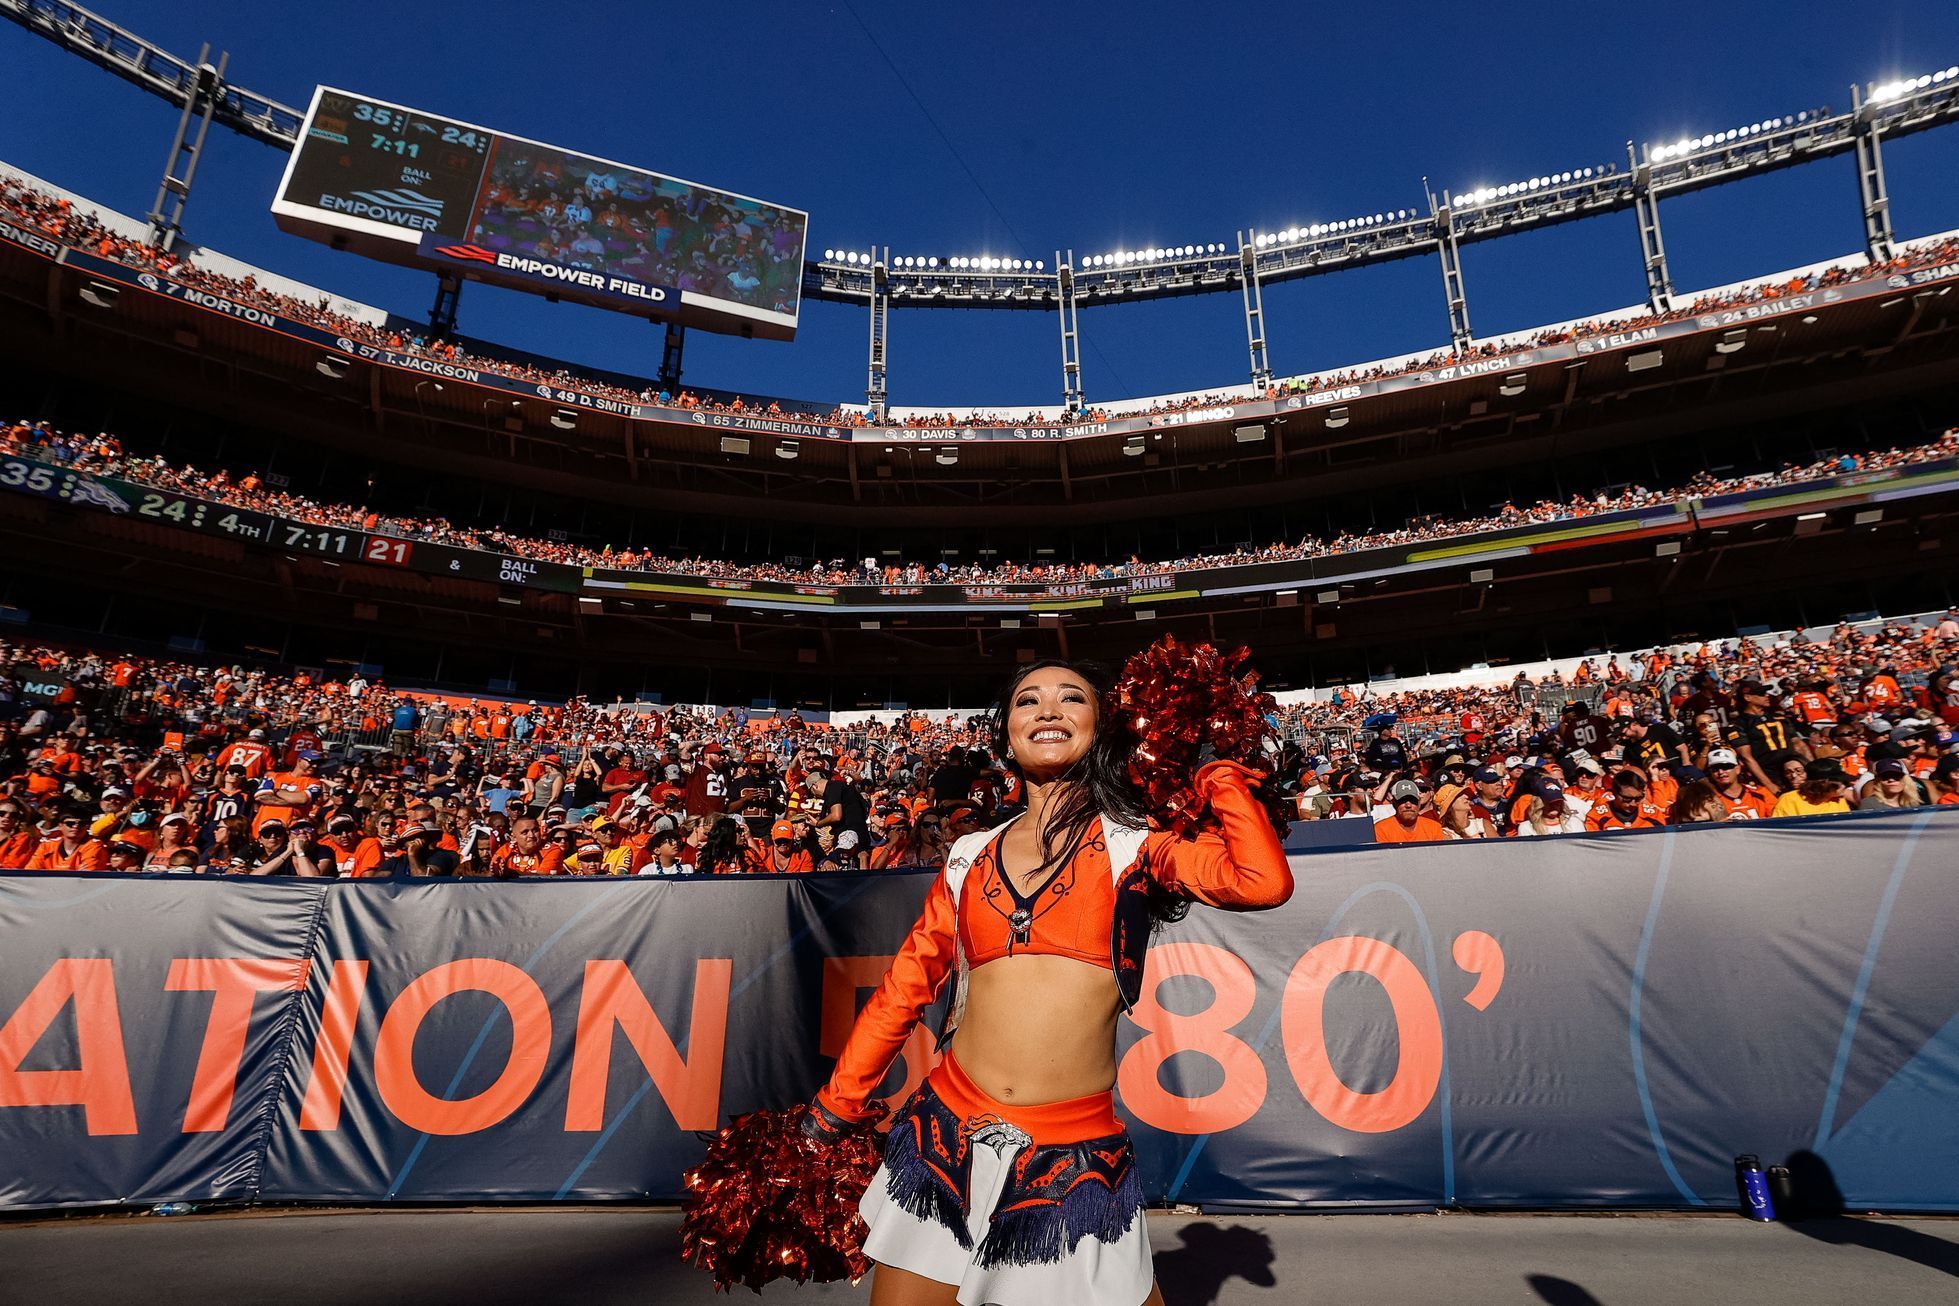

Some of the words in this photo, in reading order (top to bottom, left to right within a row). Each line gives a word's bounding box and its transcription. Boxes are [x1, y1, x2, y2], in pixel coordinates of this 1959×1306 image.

[353, 103, 391, 126] 35
[370, 133, 420, 159] 7:11
[441, 126, 476, 148] 24
[402, 166, 432, 181] BALL
[319, 193, 439, 232] EMPOWER
[497, 253, 605, 290] EMPOWER
[609, 278, 666, 301] FIELD
[166, 282, 180, 294] 7
[184, 289, 276, 327] MORTON
[1721, 310, 1743, 324] 24
[1746, 294, 1814, 319] BAILEY
[1597, 337, 1606, 350] 1
[1610, 328, 1658, 347] ELAM
[358, 345, 379, 359] 57
[385, 352, 396, 364] T.
[399, 357, 480, 382] JACKSON
[1438, 367, 1456, 380] 47
[1460, 357, 1511, 377] LYNCH
[556, 389, 576, 402] 49
[579, 395, 593, 407] D.
[596, 399, 641, 416] SMITH
[1305, 386, 1361, 405] REEVES
[713, 416, 730, 427] 65
[734, 418, 822, 436] ZIMMERMAN
[902, 429, 917, 440] 30
[921, 429, 957, 440] DAVIS
[1031, 429, 1046, 439] 80
[1050, 429, 1062, 439] R.
[1065, 424, 1107, 438] SMITH
[1, 462, 55, 491] 35
[138, 493, 187, 522] 24
[217, 513, 261, 538] 4TH
[284, 526, 347, 553] 7:11
[368, 539, 407, 563] 21
[449, 559, 461, 571] &
[500, 559, 538, 575] BALL
[499, 570, 526, 584] ON:
[1132, 576, 1171, 591] KING
[123, 667, 133, 677] 7
[497, 717, 507, 725] 18
[1574, 725, 1597, 746] 90
[1756, 721, 1787, 751] 17
[230, 747, 262, 767] 87
[213, 801, 238, 821] 10
